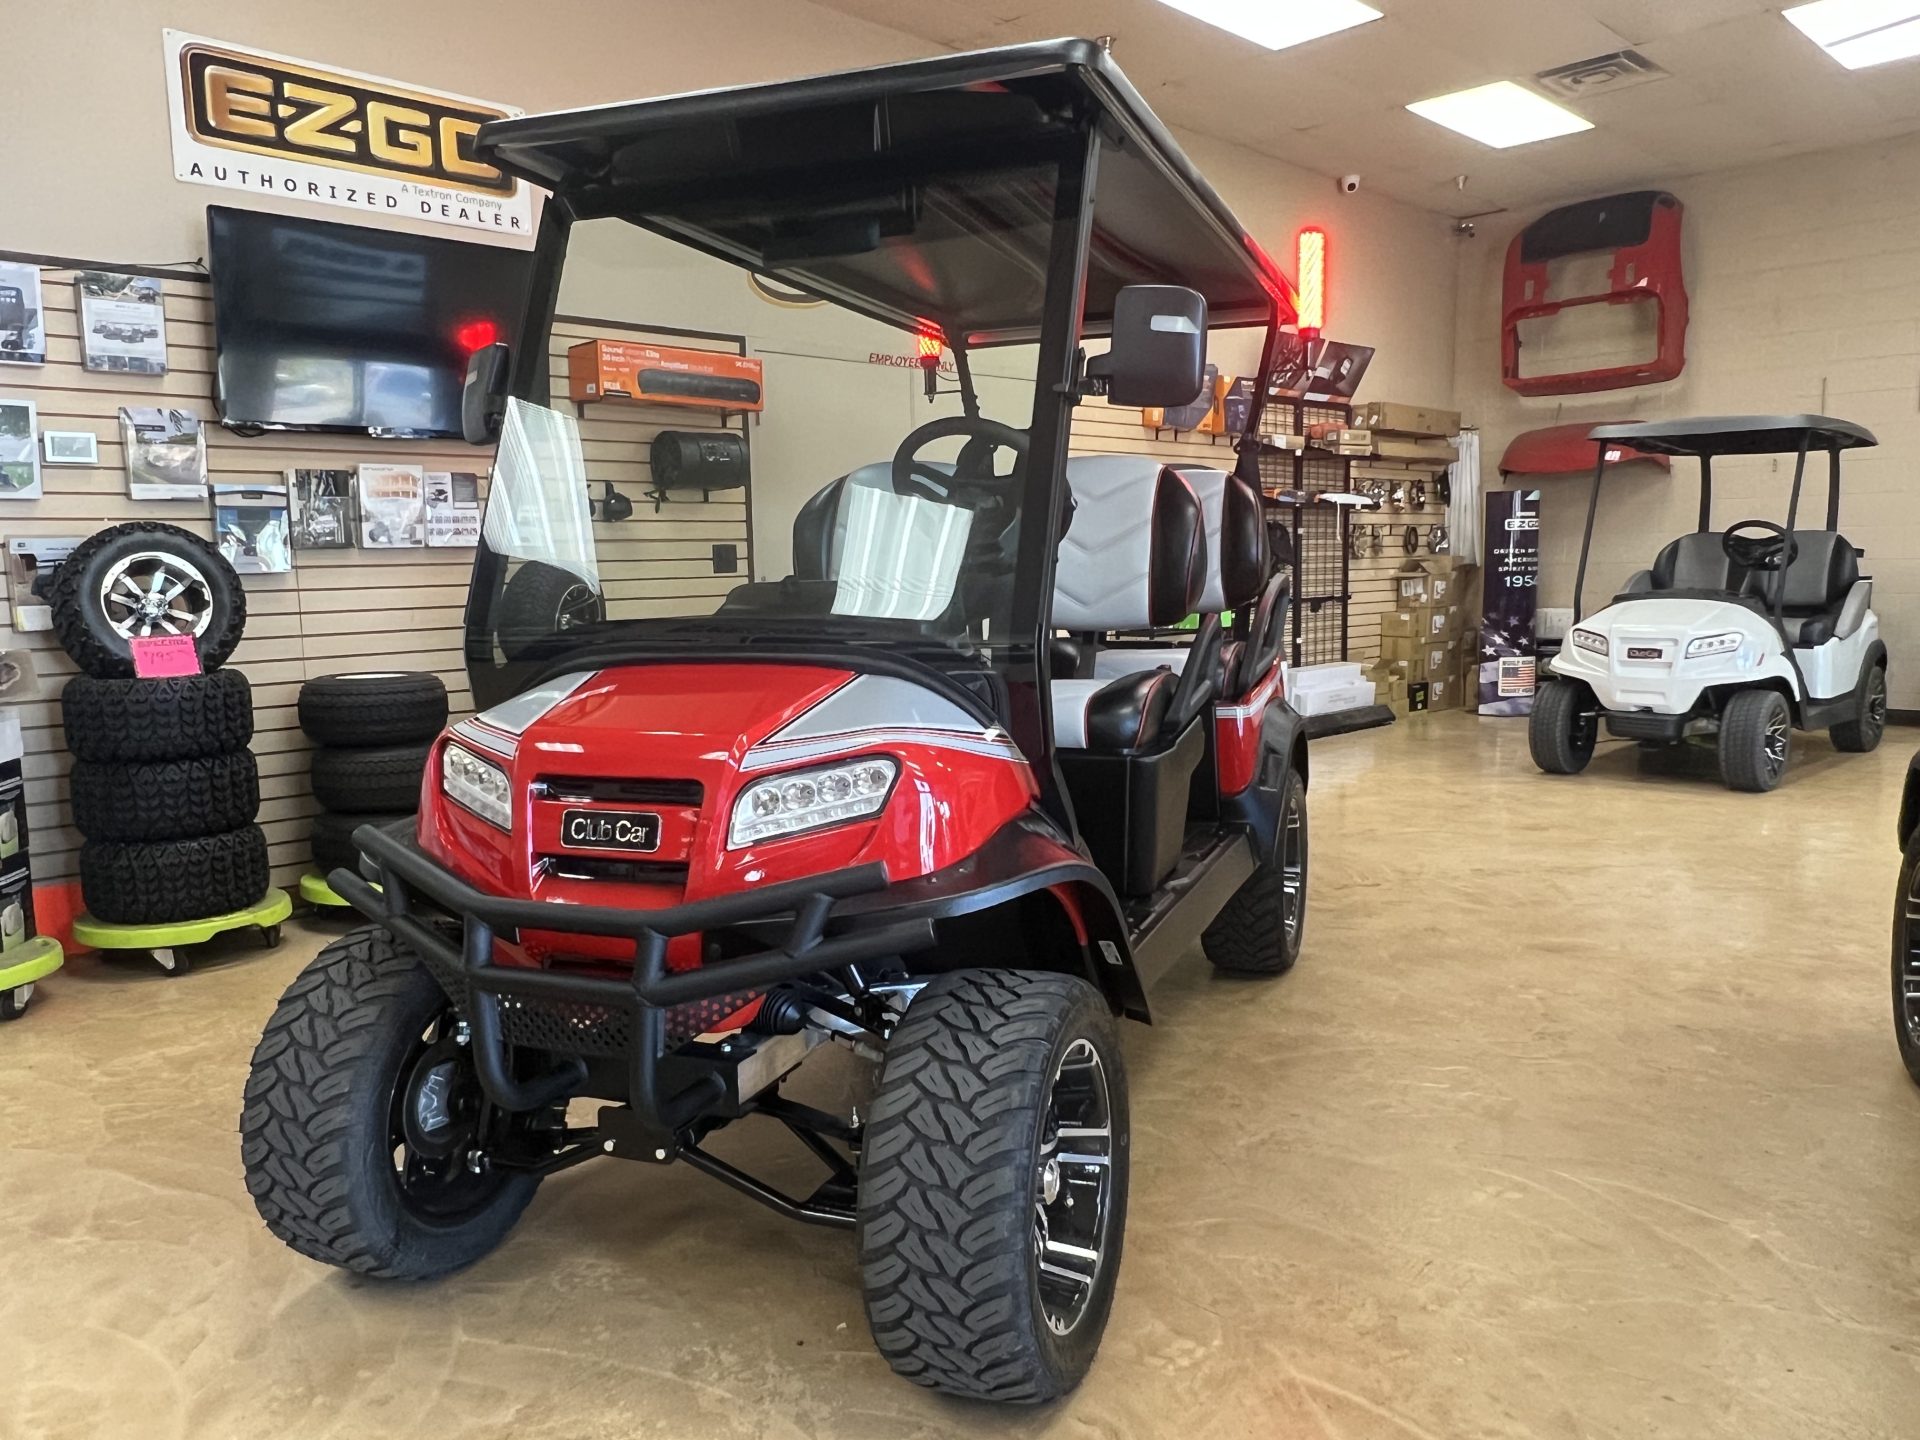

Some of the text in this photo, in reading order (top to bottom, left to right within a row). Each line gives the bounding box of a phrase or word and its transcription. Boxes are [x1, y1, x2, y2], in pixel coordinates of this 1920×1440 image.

[190, 162, 520, 229] AUTHORIZED DEALER
[401, 184, 503, 211] A Textron Company
[868, 352, 923, 369] EMPLOYEE
[571, 818, 650, 843] Club Car
